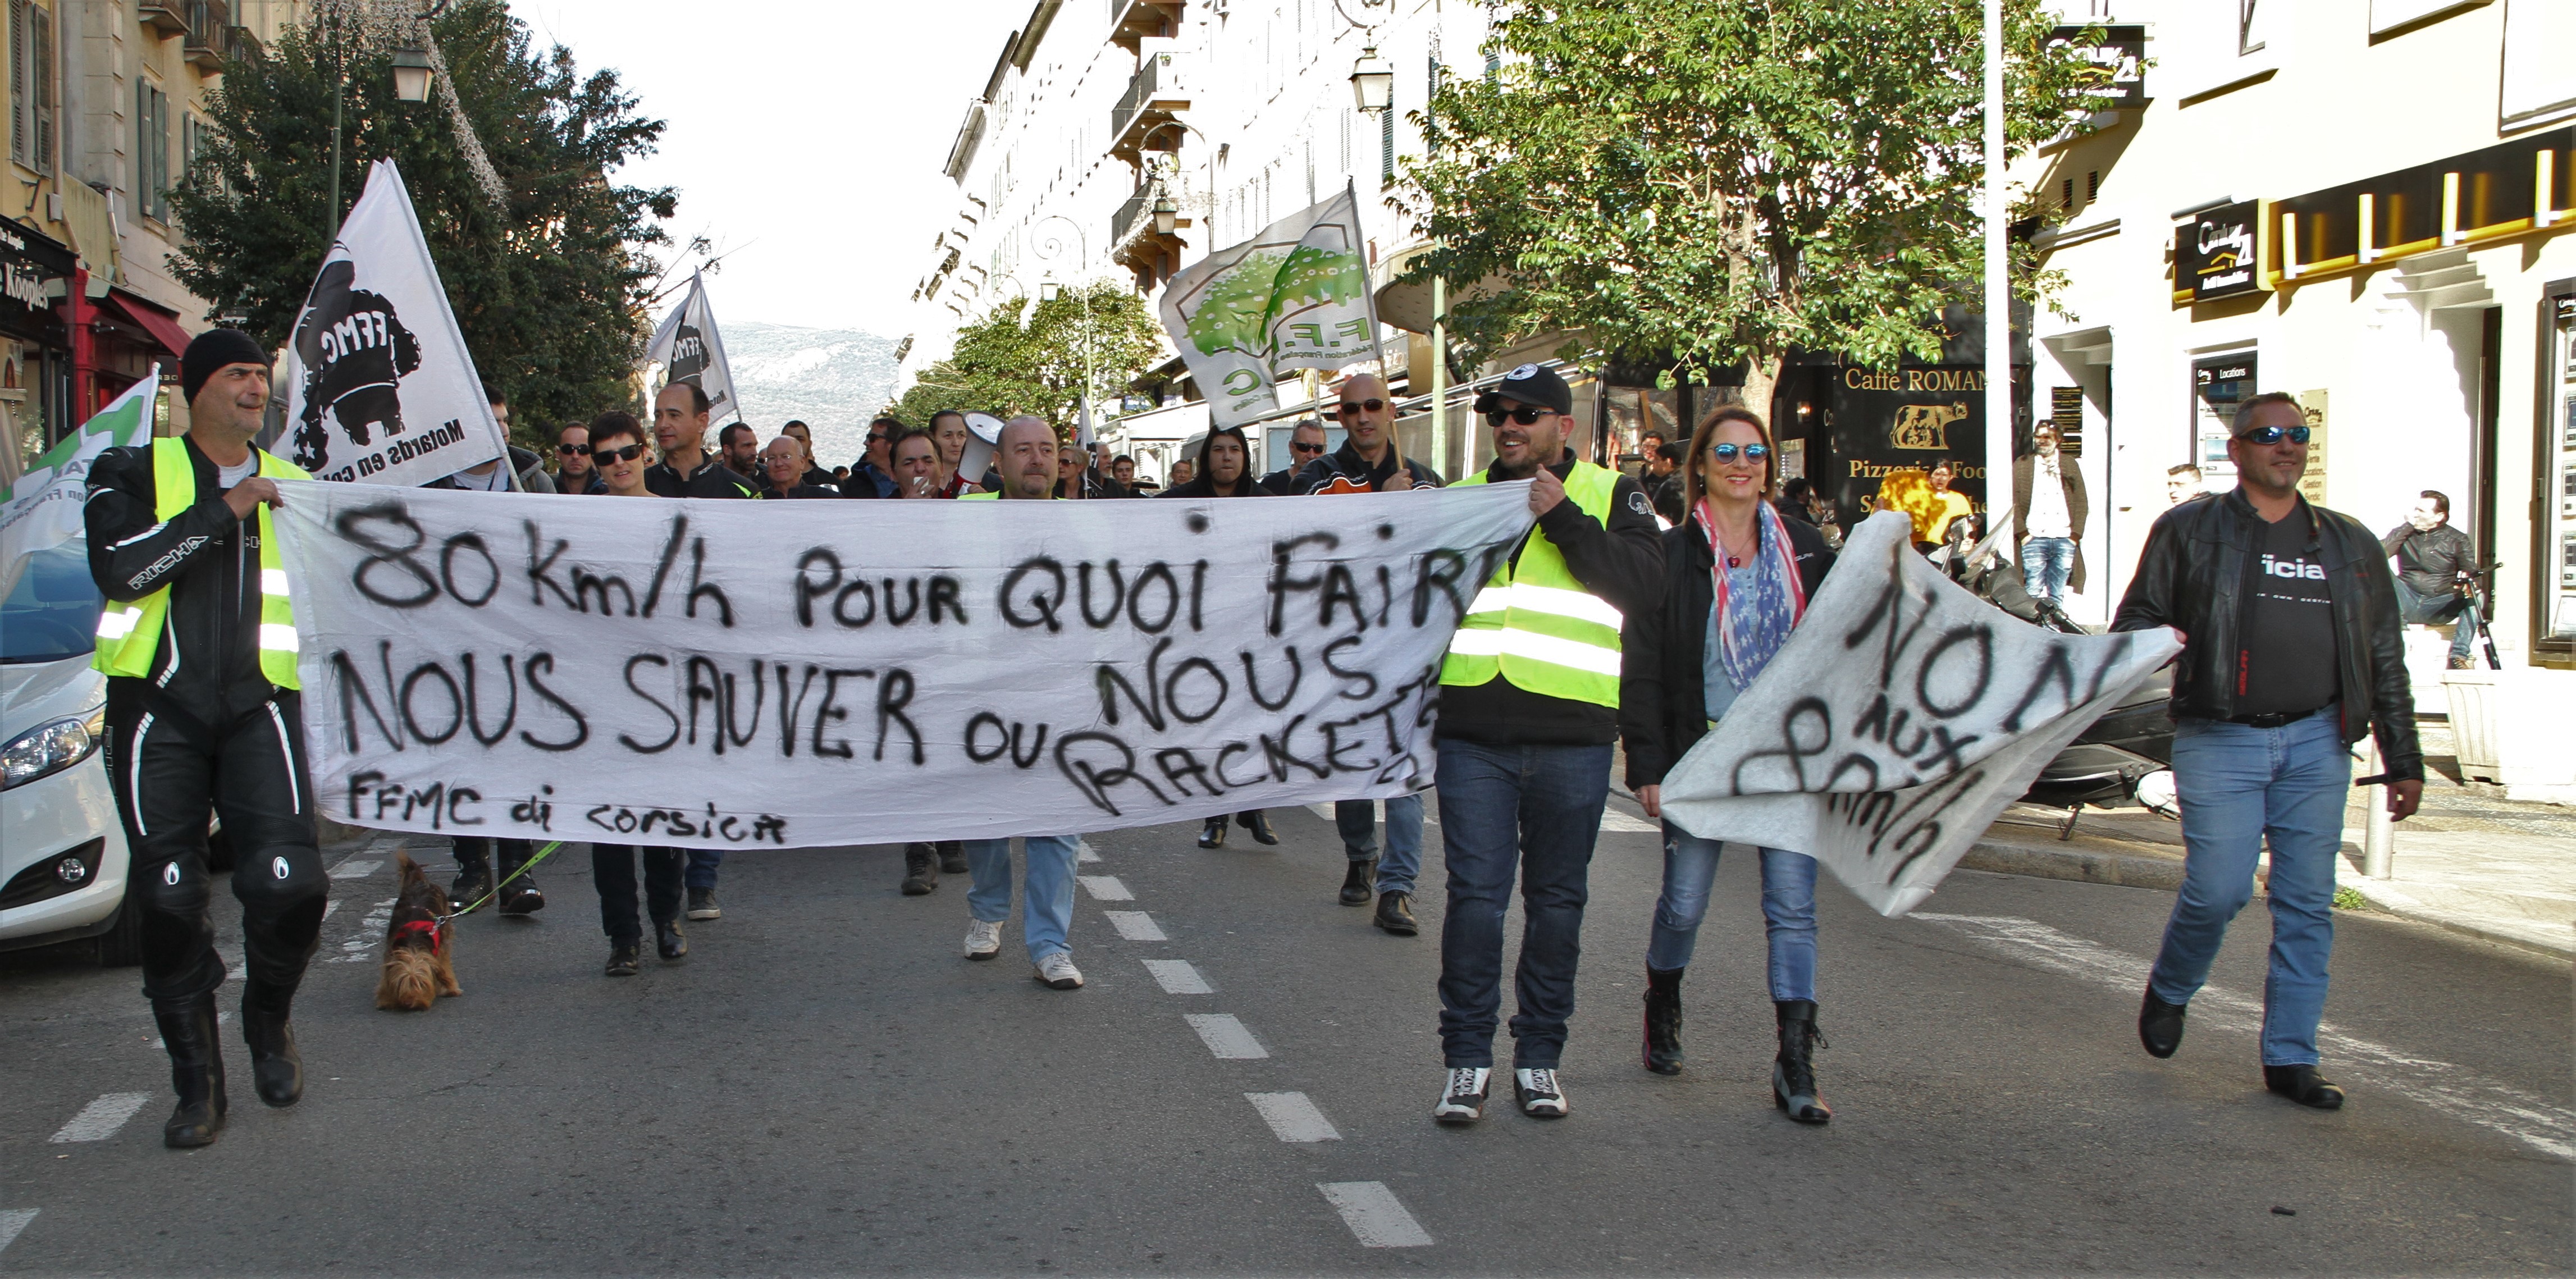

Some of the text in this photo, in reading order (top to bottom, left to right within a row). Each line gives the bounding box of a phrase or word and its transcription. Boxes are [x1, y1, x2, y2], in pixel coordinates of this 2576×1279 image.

[6, 262, 49, 312] Kooples
[2219, 367, 2246, 379] Locations
[127, 535, 209, 590] RICHA
[335, 499, 501, 608] 80
[794, 545, 968, 629] POUR
[1845, 540, 2134, 732] NON
[330, 640, 589, 753] NOUS
[619, 651, 925, 765] SAUVER
[1095, 635, 1378, 732] NOUS
[1853, 692, 1980, 772] AUX
[347, 770, 486, 830] FFMC
[510, 784, 555, 833] di
